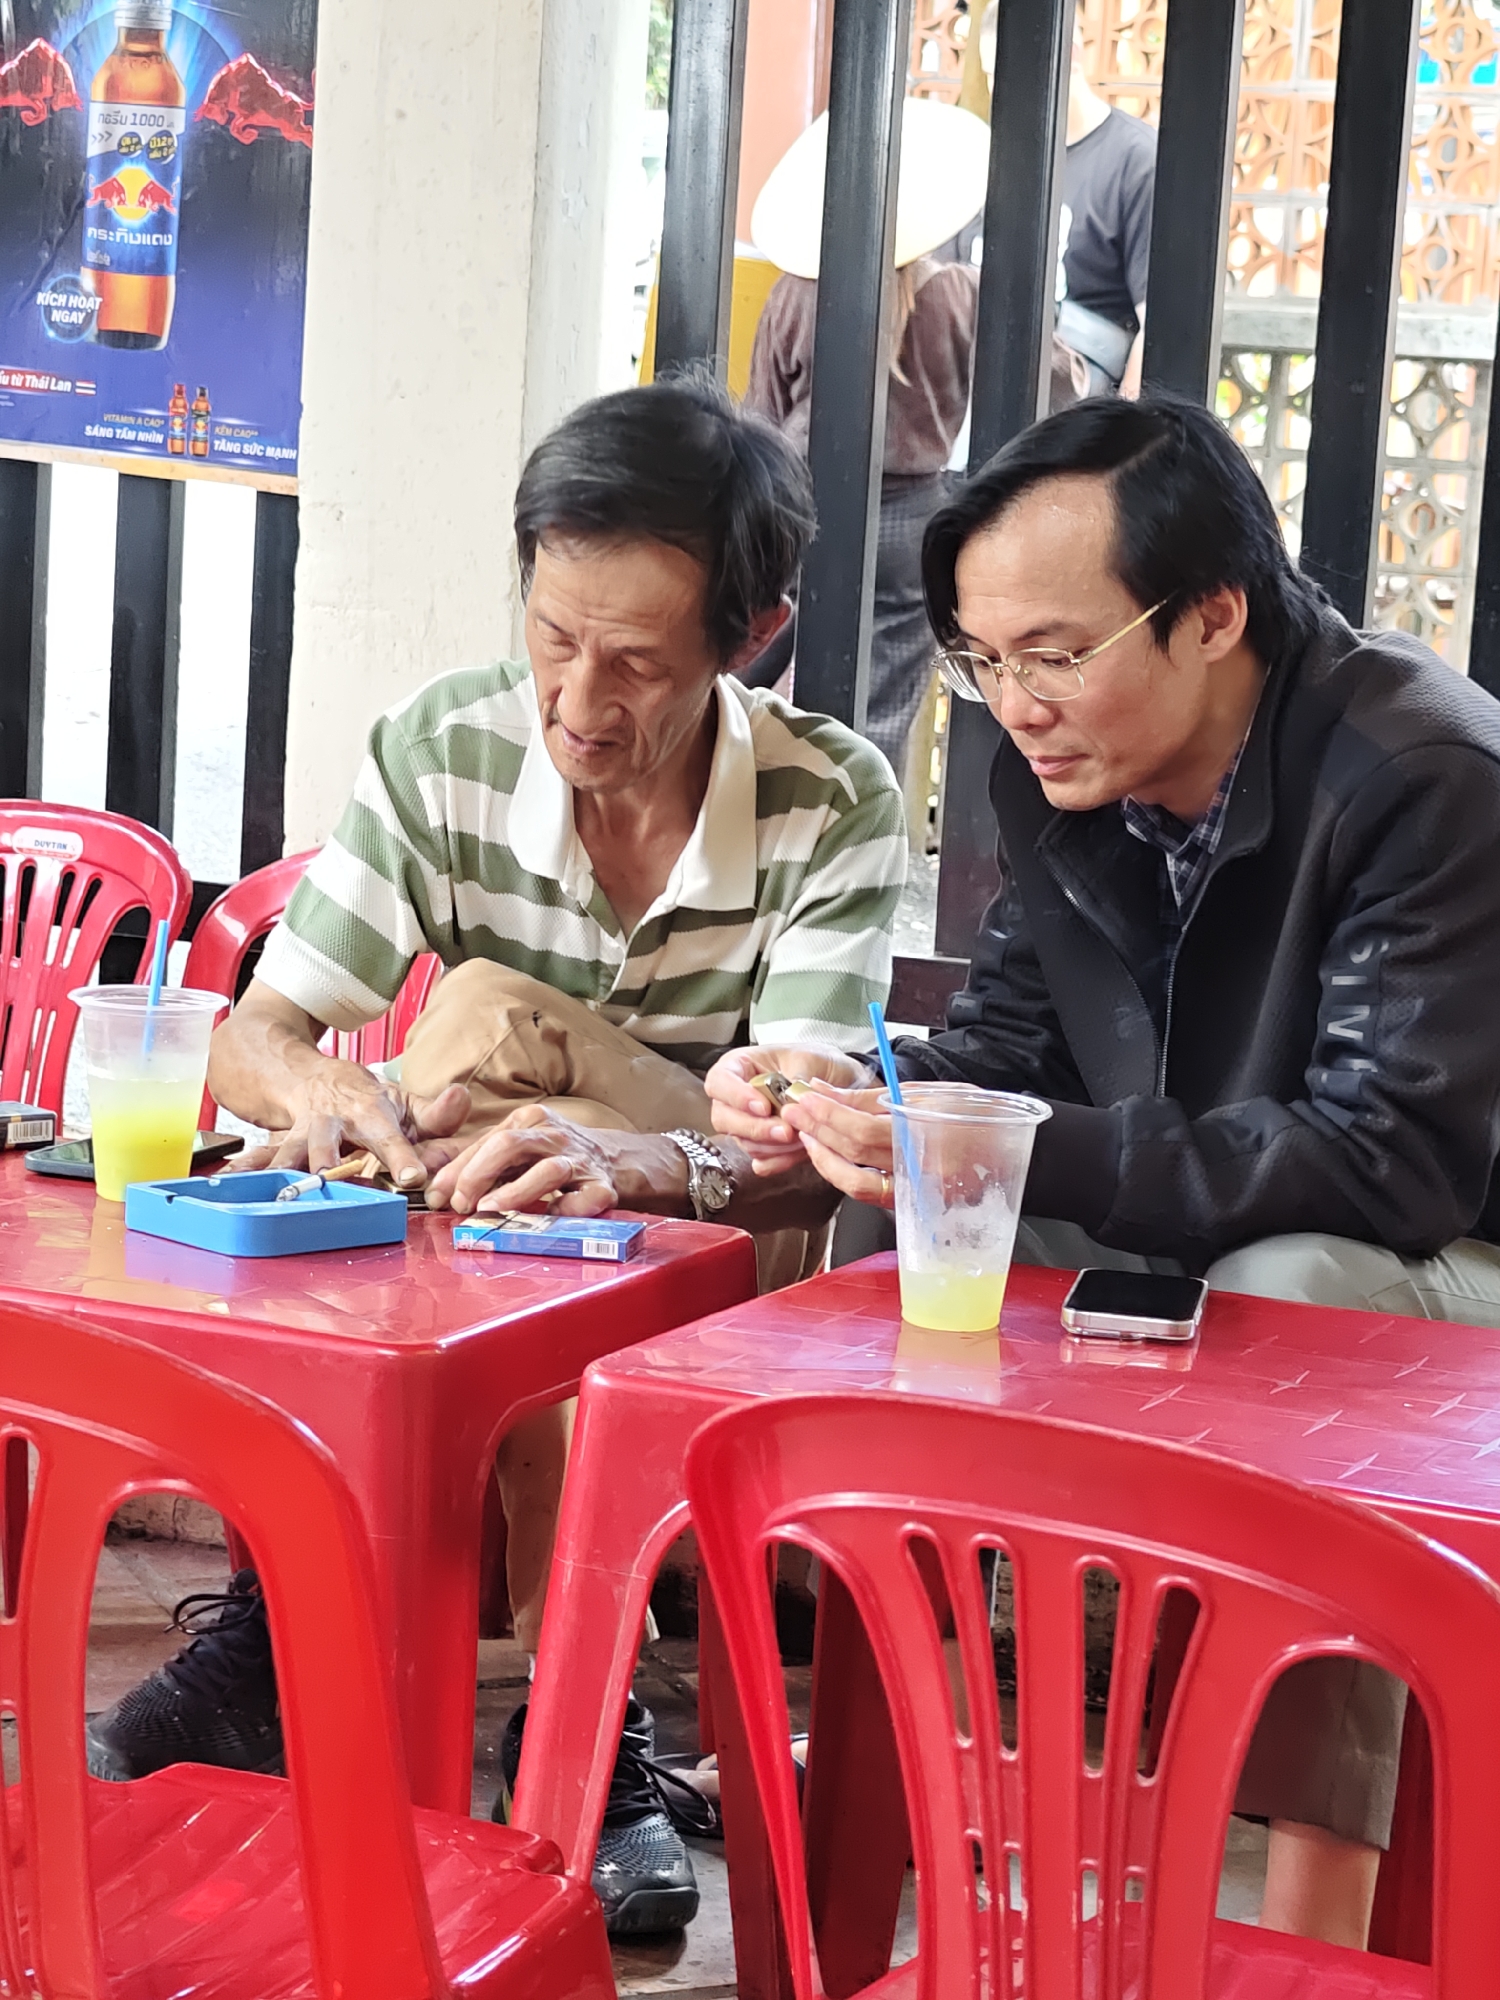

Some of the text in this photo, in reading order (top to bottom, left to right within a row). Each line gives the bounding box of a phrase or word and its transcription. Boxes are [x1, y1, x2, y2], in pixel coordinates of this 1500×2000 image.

[130, 112, 165, 128] 1000
[36, 290, 103, 313] KÍCH HOẠT
[50, 309, 86, 325] NGAY
[24, 373, 51, 390] Thái
[49, 376, 72, 392] Lan
[136, 417, 143, 426] A
[84, 423, 114, 439] SÁNG
[136, 429, 165, 445] NHÌN
[213, 438, 242, 454] TĂNG
[265, 445, 298, 461] MẠNH
